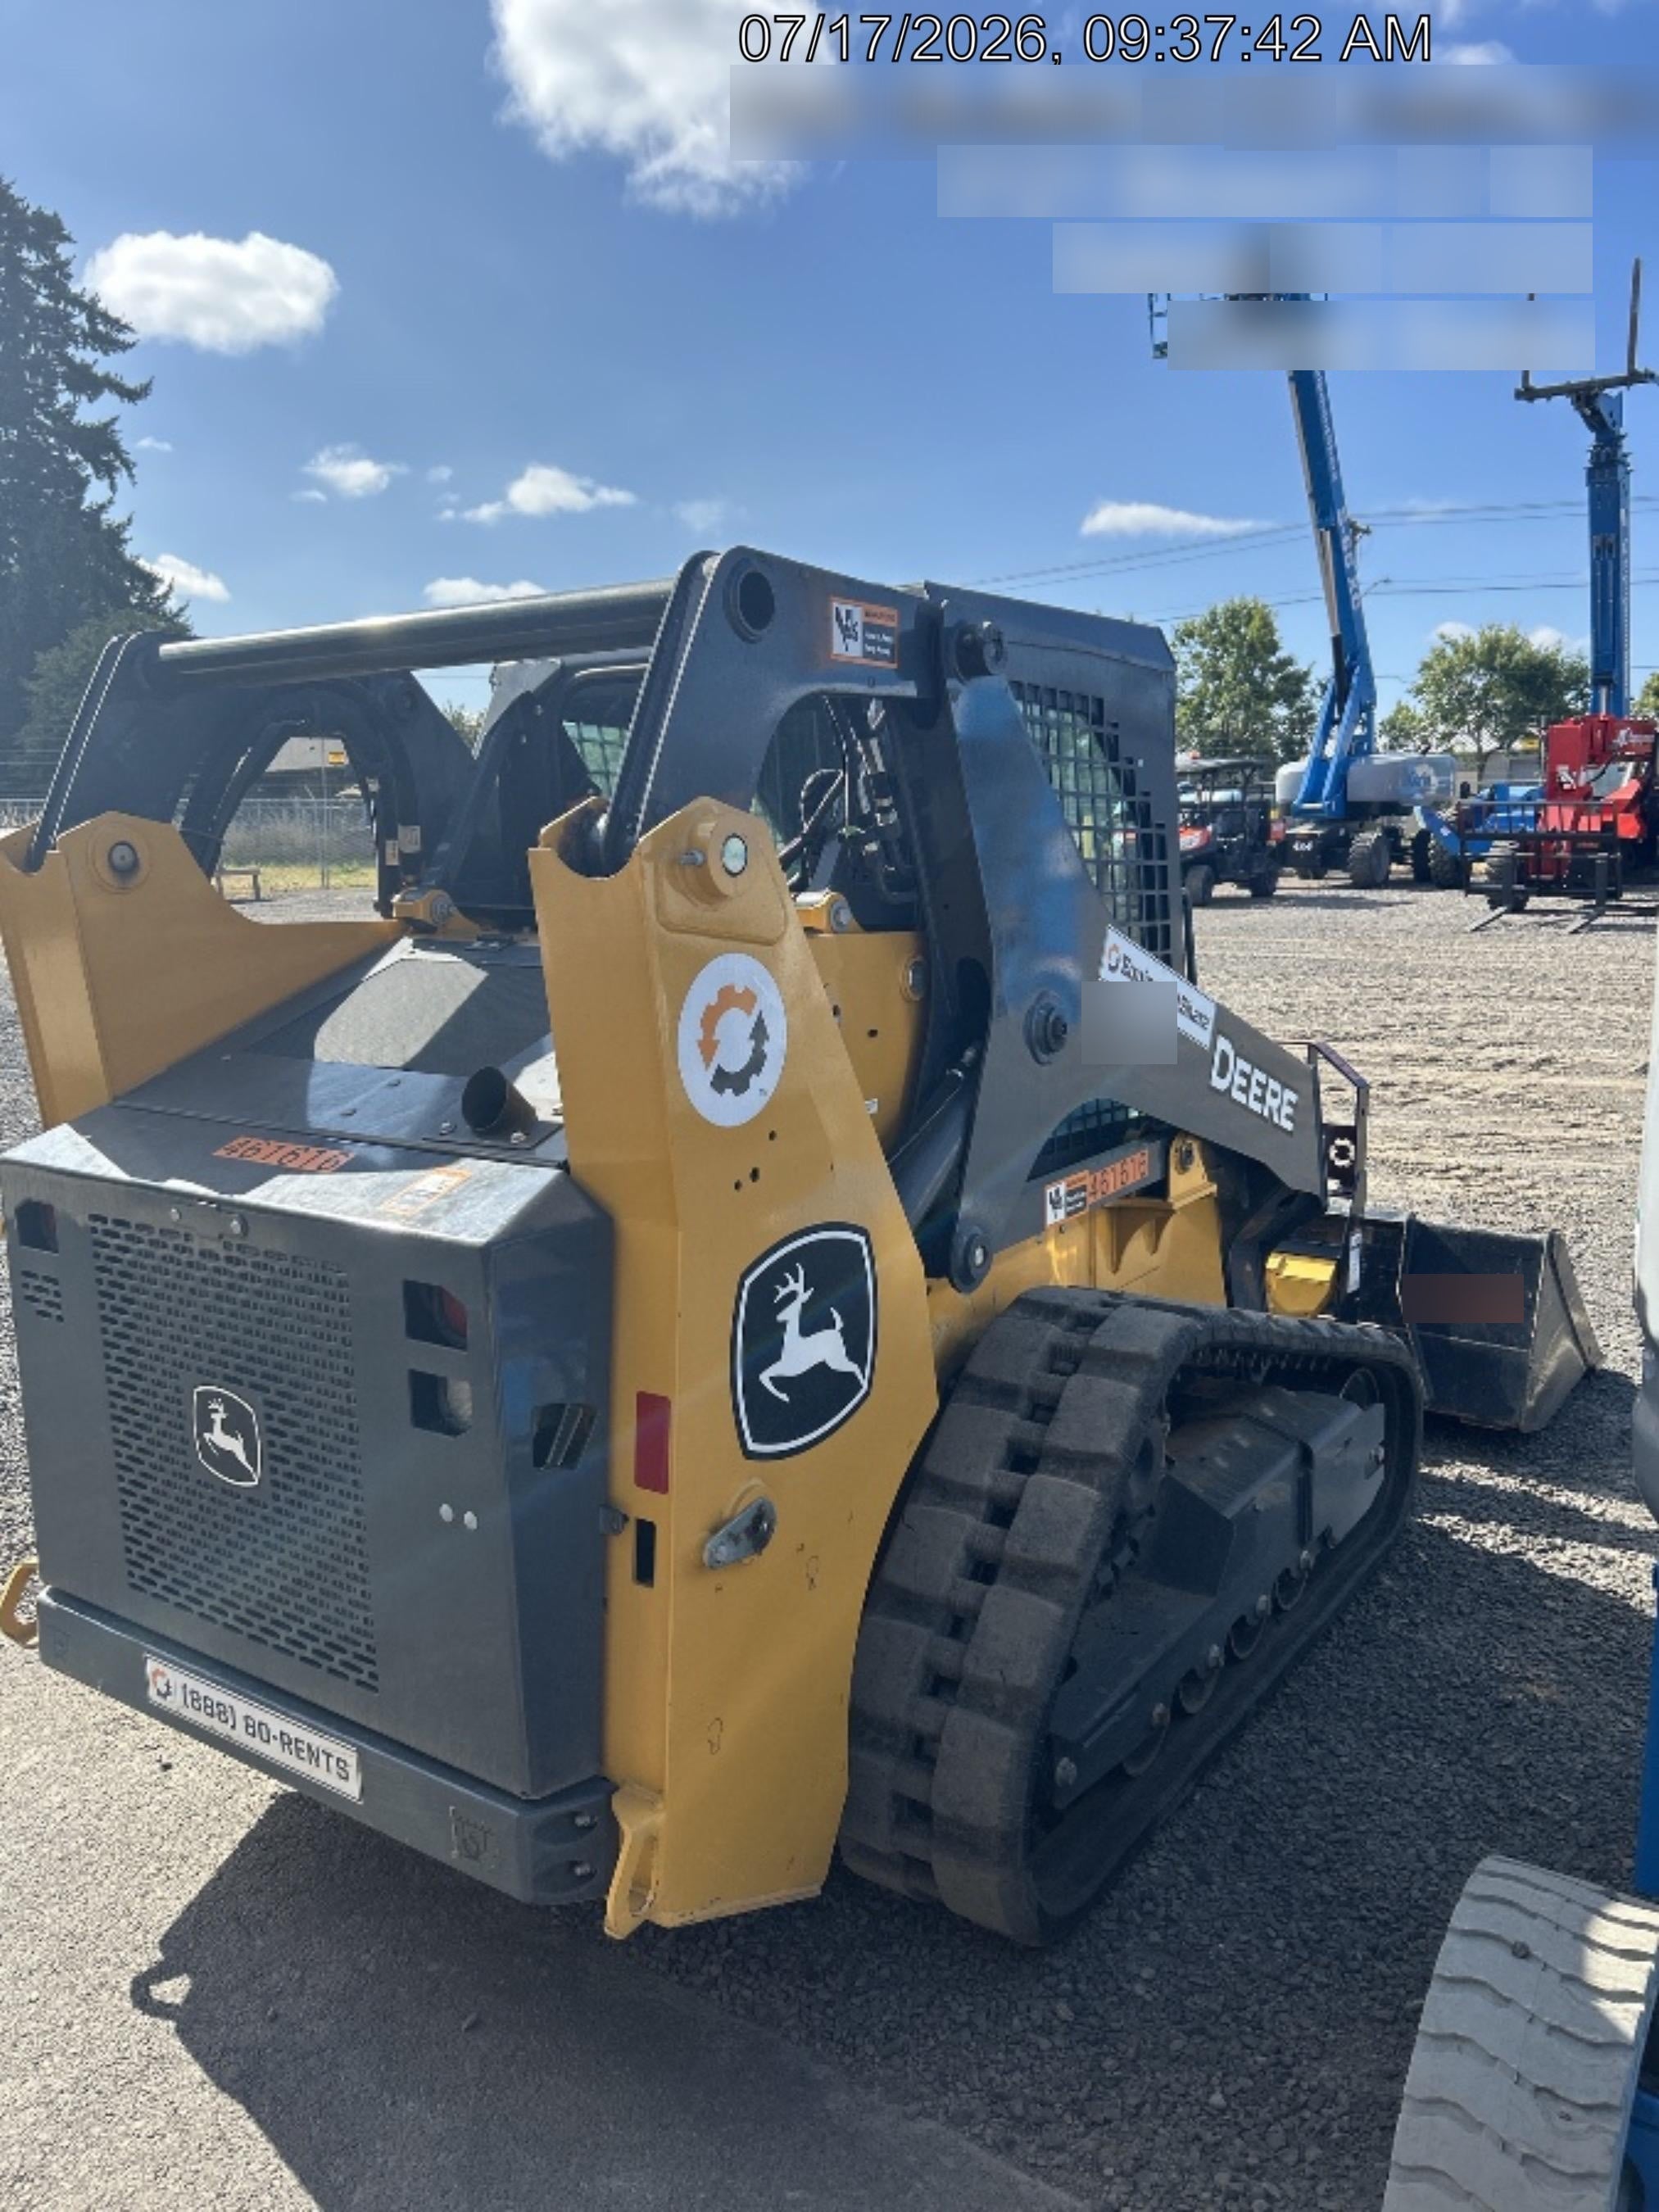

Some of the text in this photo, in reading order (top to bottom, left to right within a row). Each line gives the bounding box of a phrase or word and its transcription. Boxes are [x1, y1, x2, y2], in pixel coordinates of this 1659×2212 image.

[1210, 1034, 1299, 1132] DEERE
[181, 1683, 350, 1783] (888) 80-RENTS
